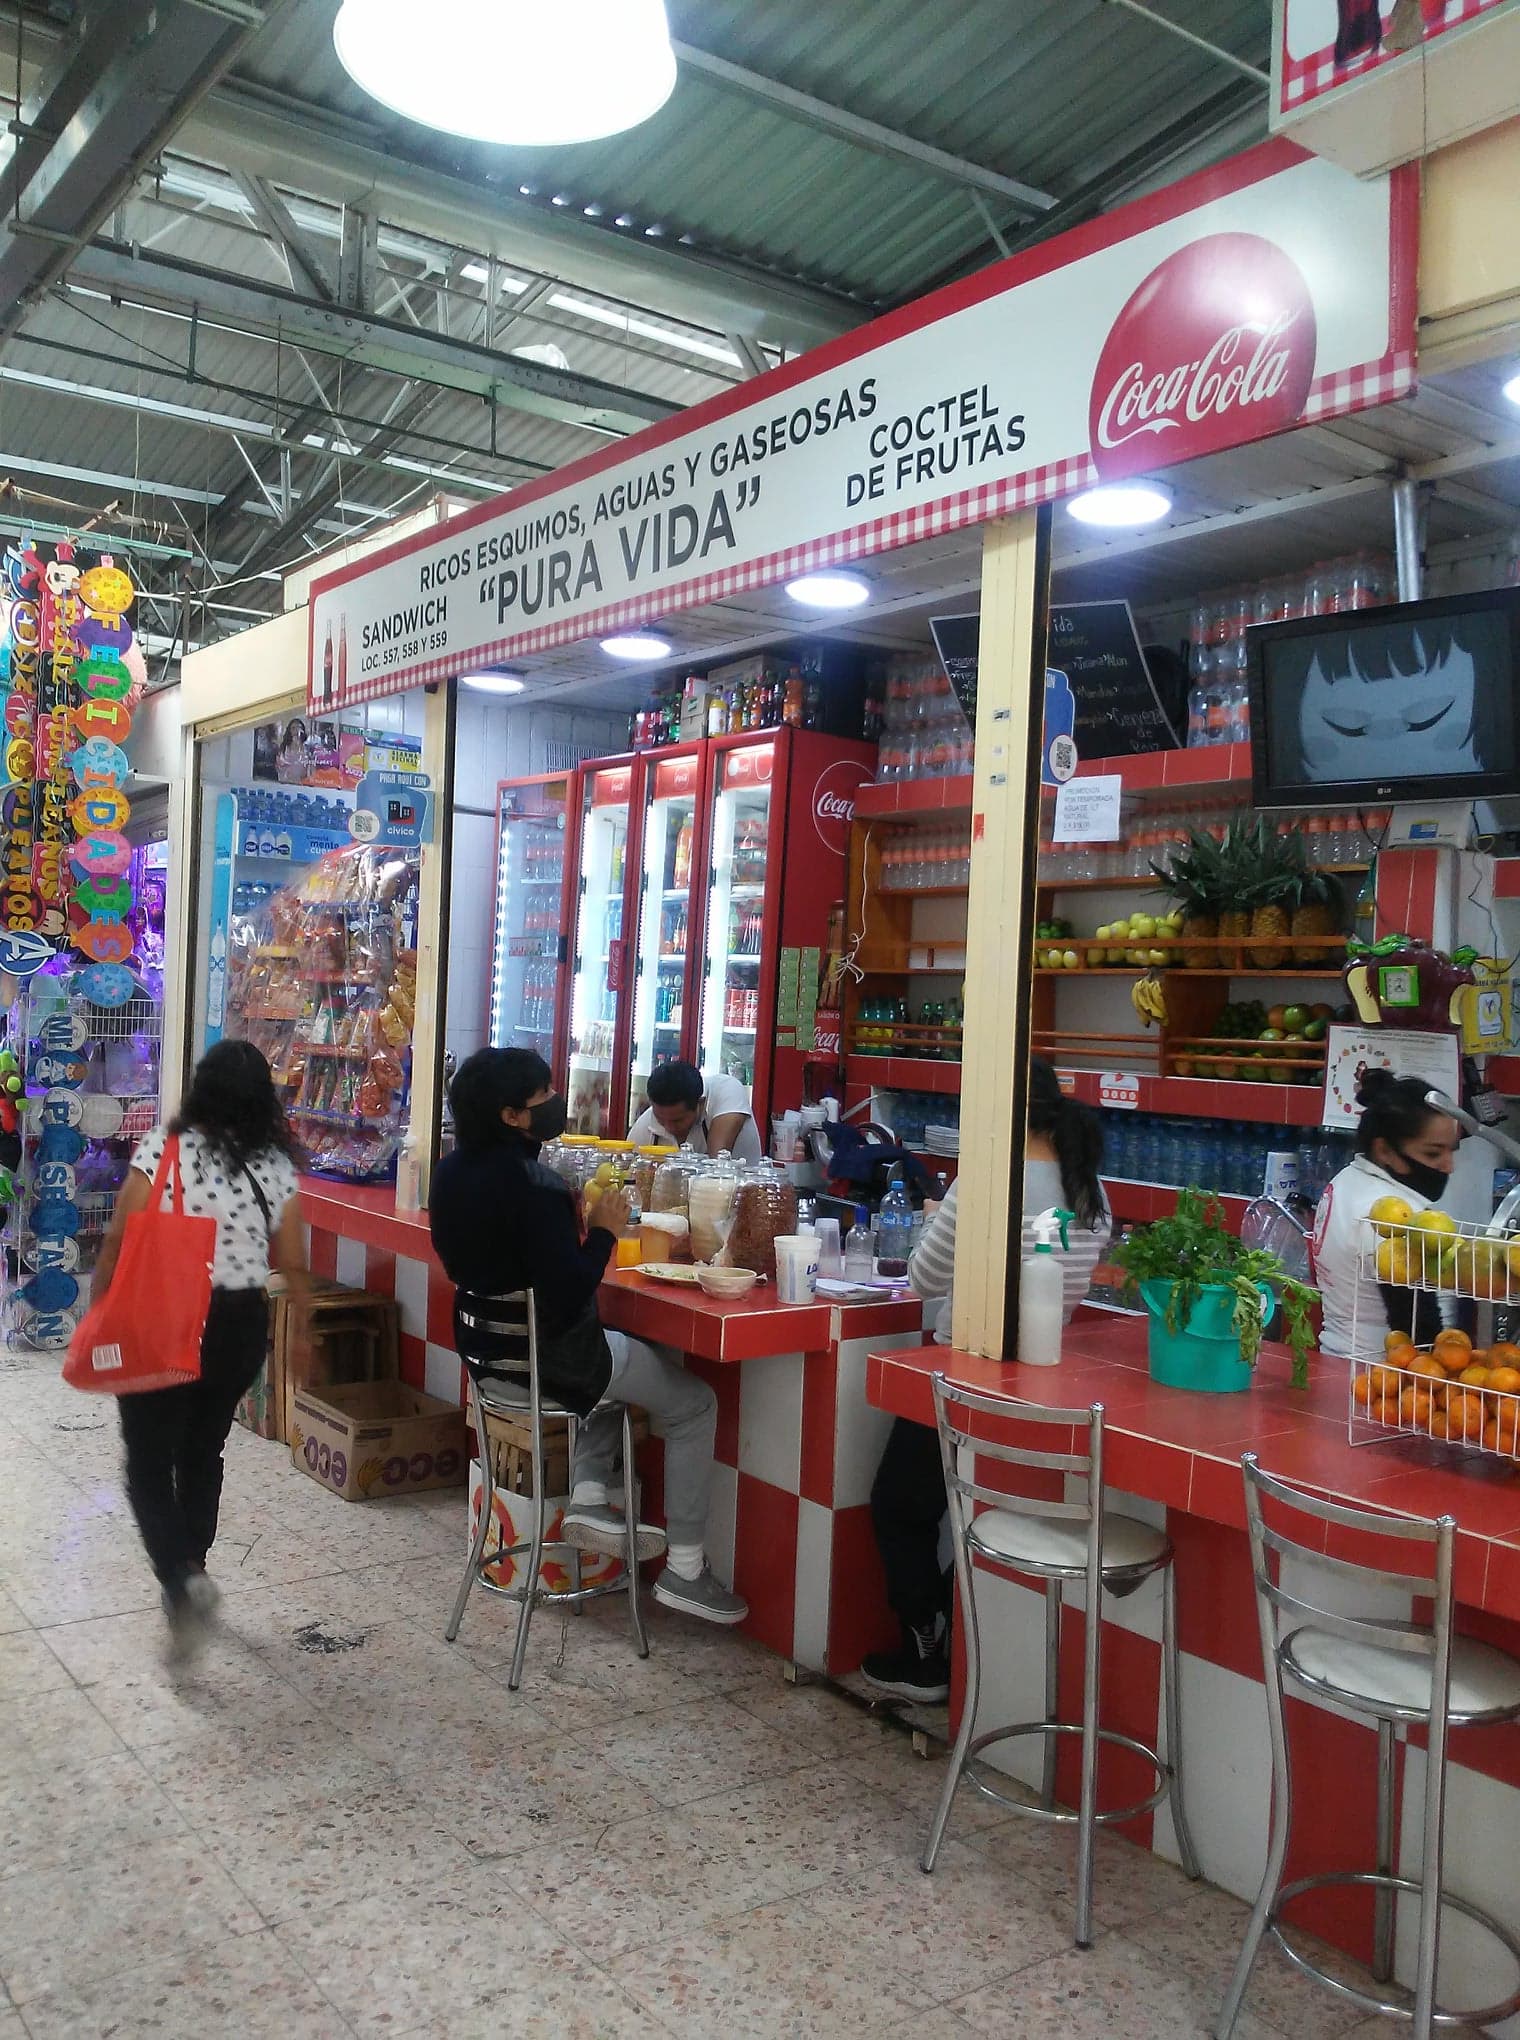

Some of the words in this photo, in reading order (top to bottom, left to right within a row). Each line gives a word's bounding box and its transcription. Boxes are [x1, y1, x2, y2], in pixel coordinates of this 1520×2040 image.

[1098, 305, 1301, 449] Coca-Cola
[846, 463, 885, 508] DE
[896, 415, 1026, 490] FRUTAS
[869, 384, 999, 458] COCTEL
[420, 549, 471, 593] RICOS
[477, 504, 586, 571] ESQUIMOS,
[593, 464, 675, 525] AGUAS
[684, 452, 701, 488] Y
[710, 378, 877, 477] GASEOSAS
[361, 656, 381, 672] LOC.
[383, 647, 400, 664] 557,
[402, 641, 418, 659] 558
[421, 637, 428, 653] Y
[430, 630, 447, 650] 559
[362, 596, 447, 649] SANDWICH
[85, 612, 121, 958] FELICIDADES
[305, 1435, 347, 1488] eco
